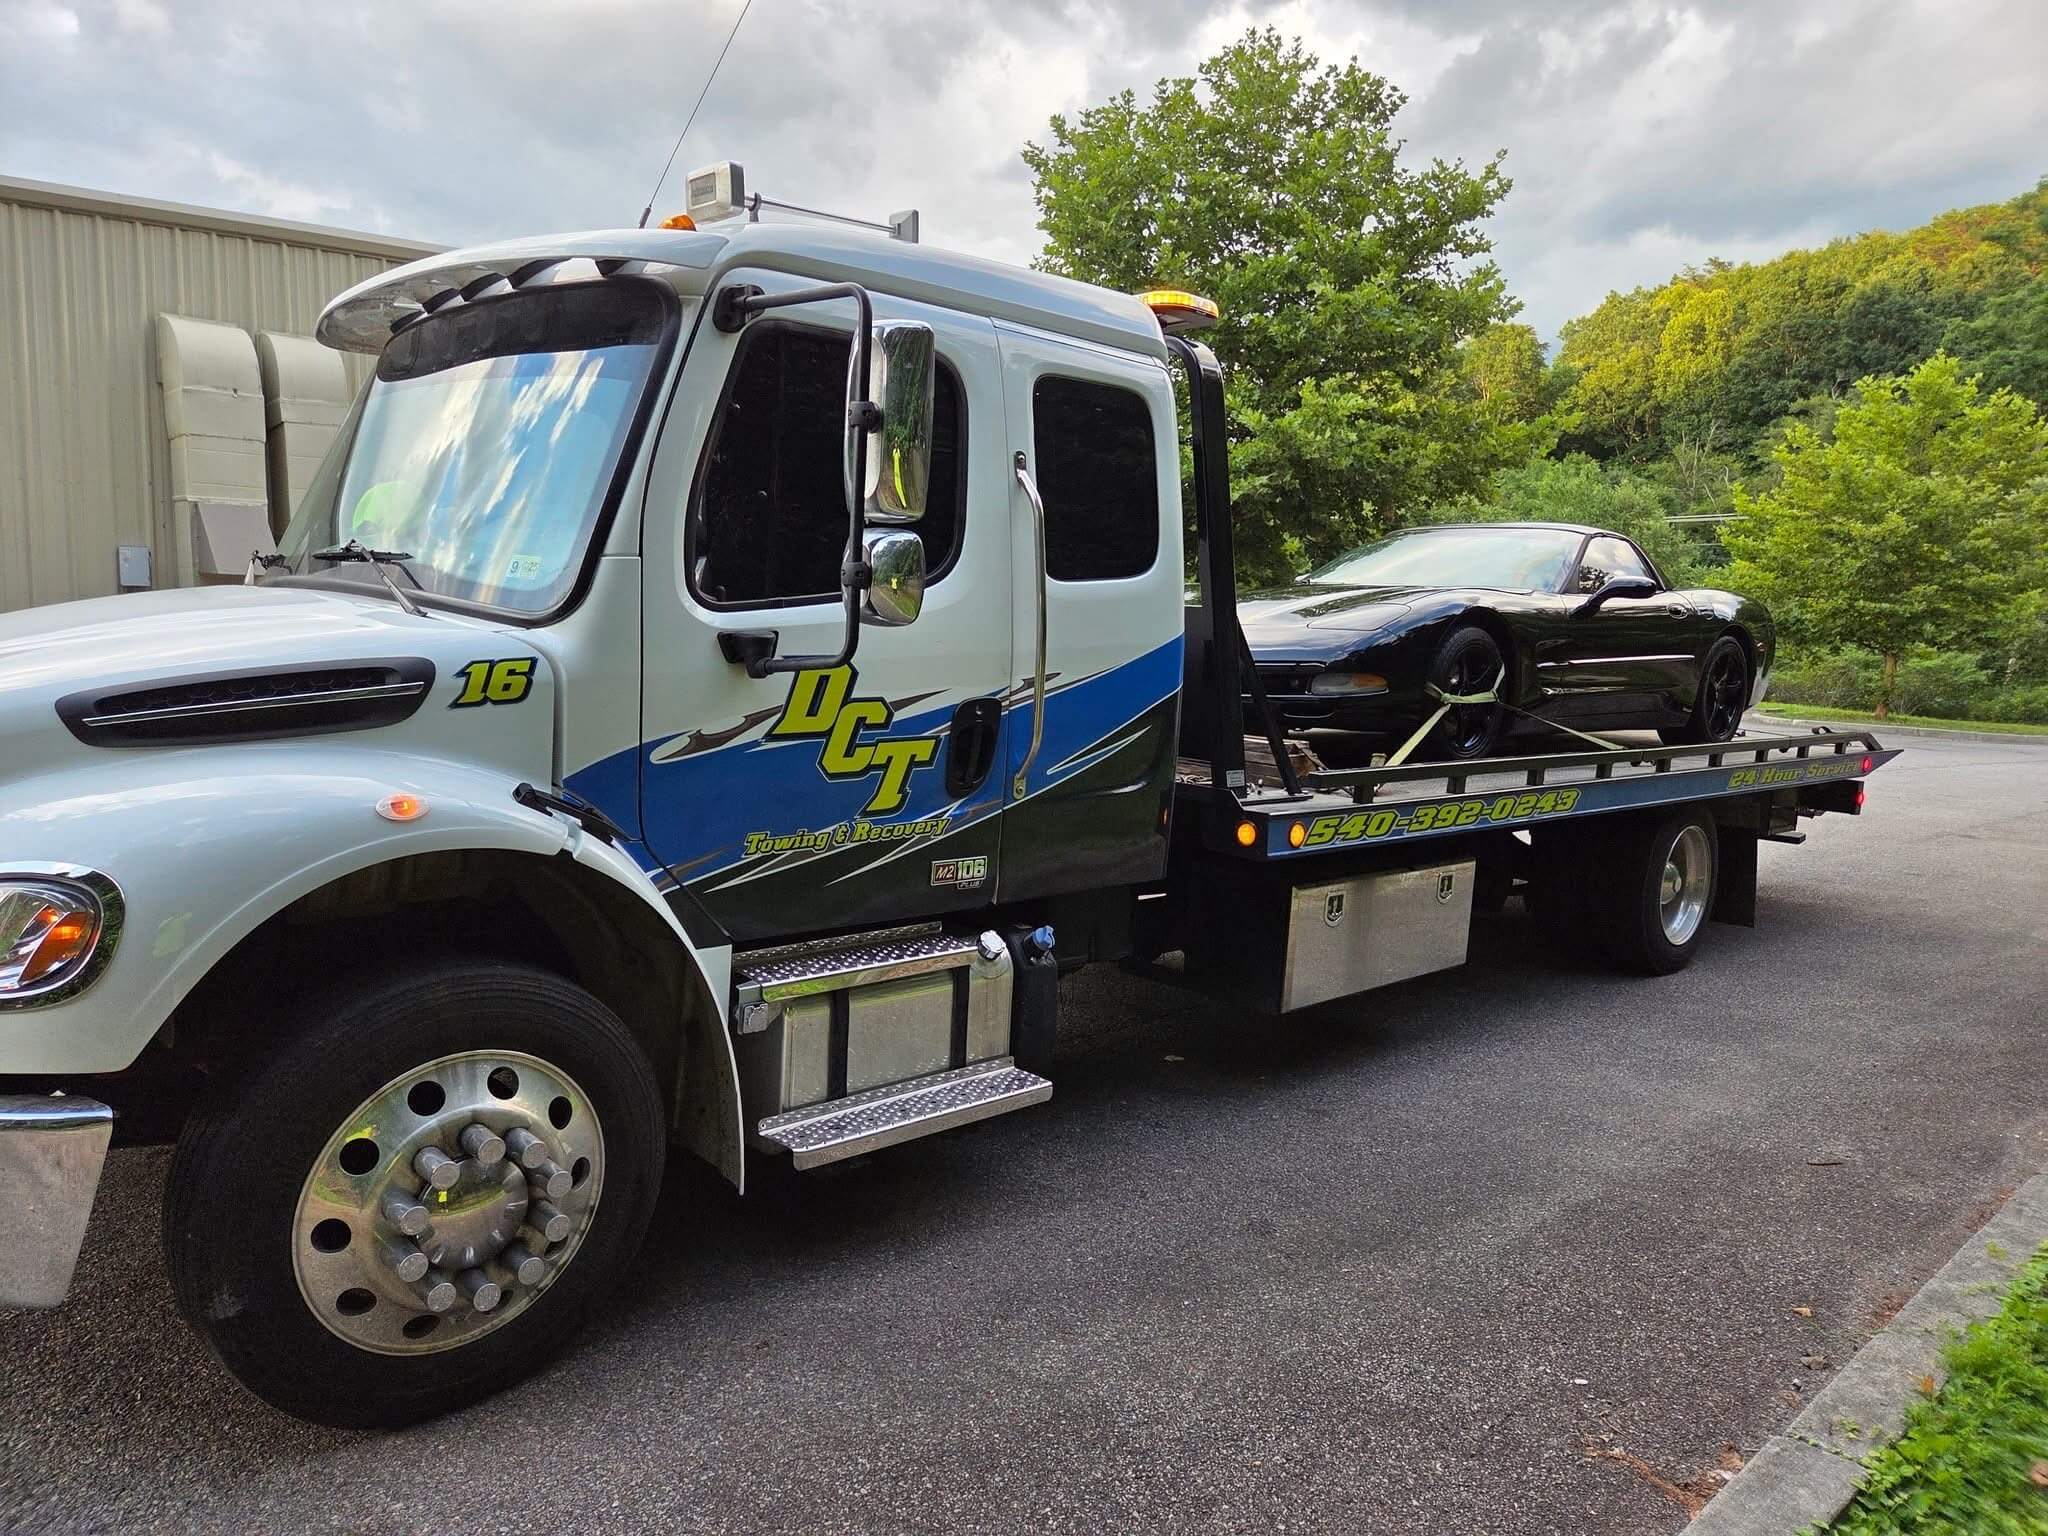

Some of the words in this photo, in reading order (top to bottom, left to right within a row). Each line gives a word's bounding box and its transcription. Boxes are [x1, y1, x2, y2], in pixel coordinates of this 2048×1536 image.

[450, 658, 537, 707] 16
[768, 664, 942, 818] DCT
[1728, 769, 1757, 790] 24
[1759, 768, 1800, 784] Hour
[744, 831, 829, 855] Towing
[835, 824, 849, 845] &
[853, 819, 949, 843] Recovery
[1303, 789, 1580, 847] 540-392-0243
[935, 864, 955, 880] M2
[957, 859, 985, 880] 106
